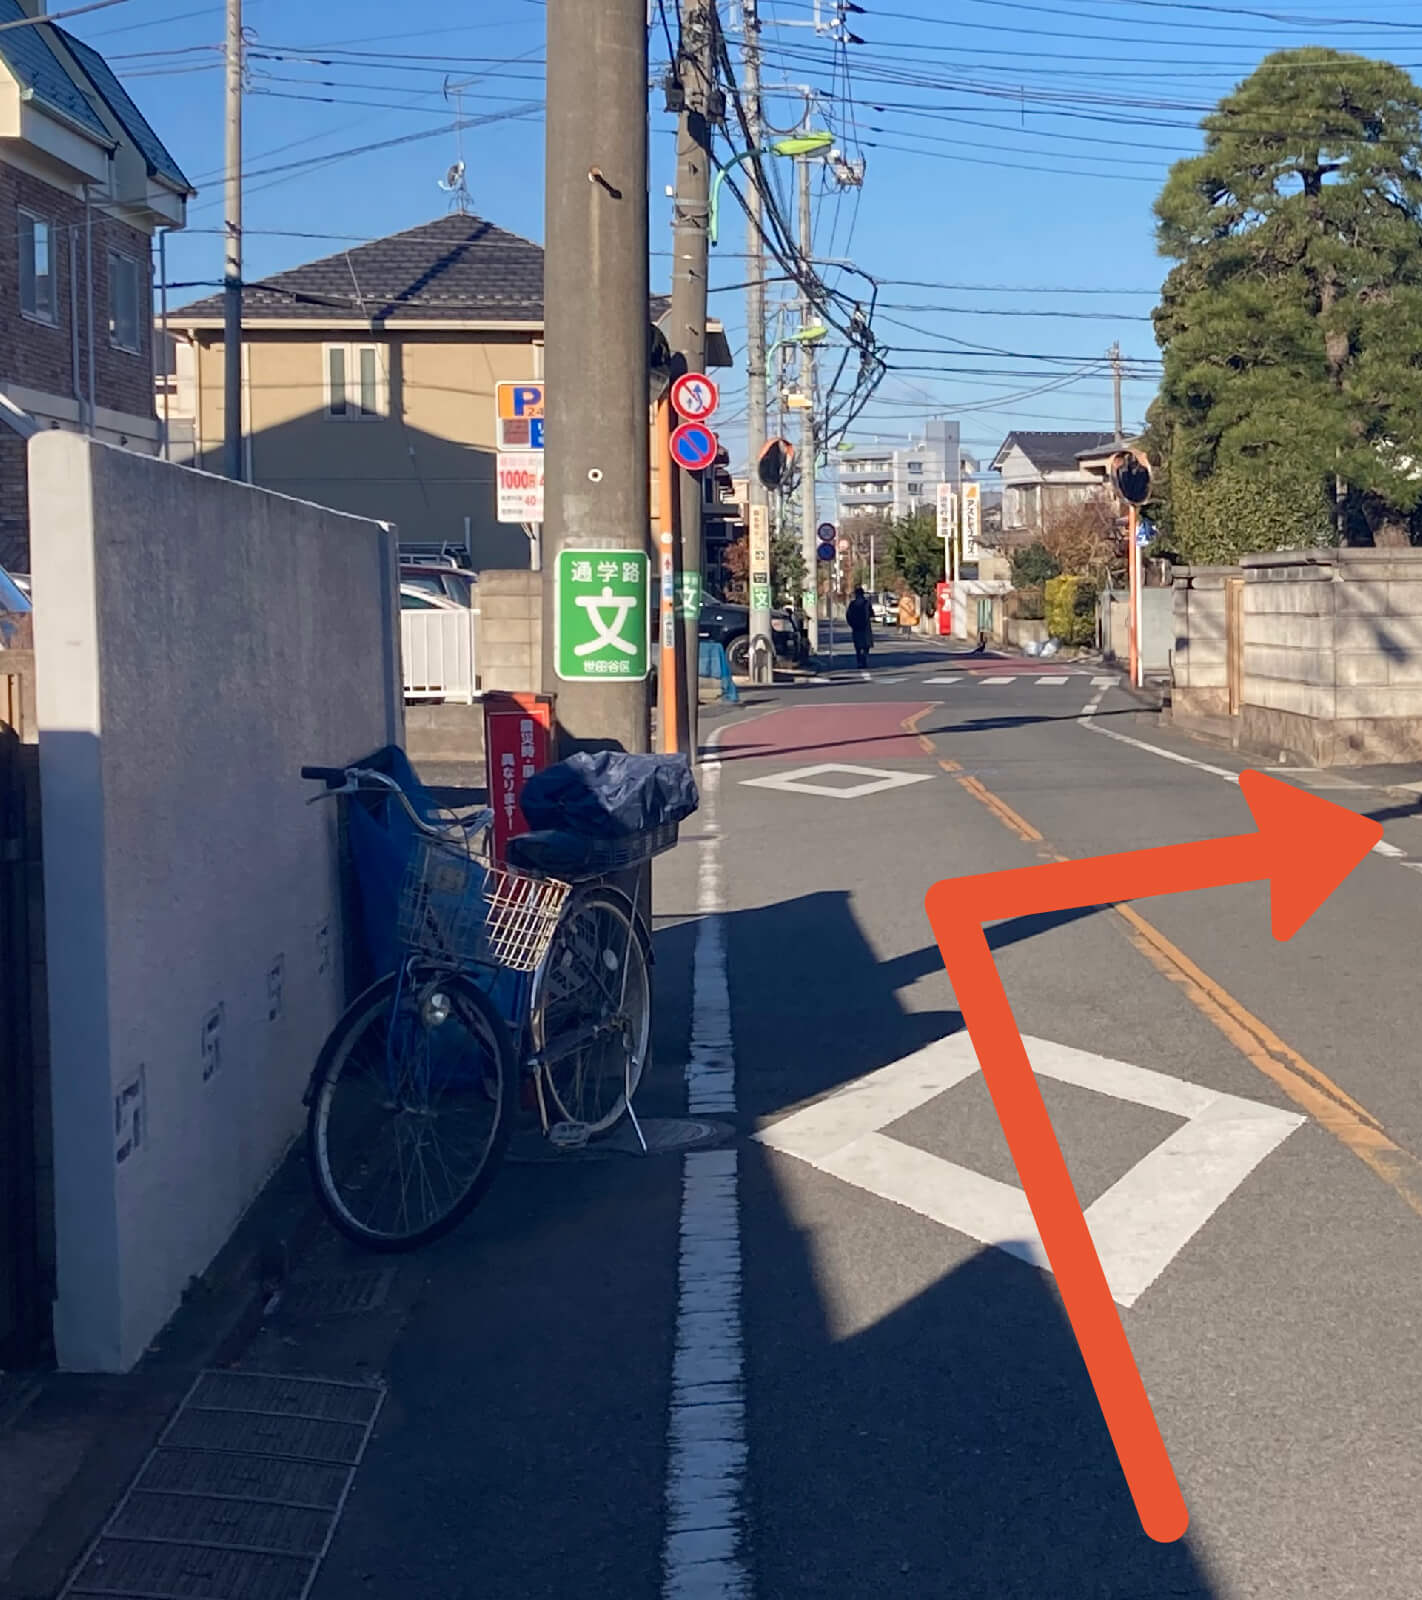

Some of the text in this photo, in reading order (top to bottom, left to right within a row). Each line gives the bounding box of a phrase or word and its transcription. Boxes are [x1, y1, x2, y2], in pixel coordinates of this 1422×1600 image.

[513, 387, 542, 416] P
[571, 560, 640, 583] 通学路
[573, 586, 638, 656] 文
[583, 660, 630, 673] 世田谷区
